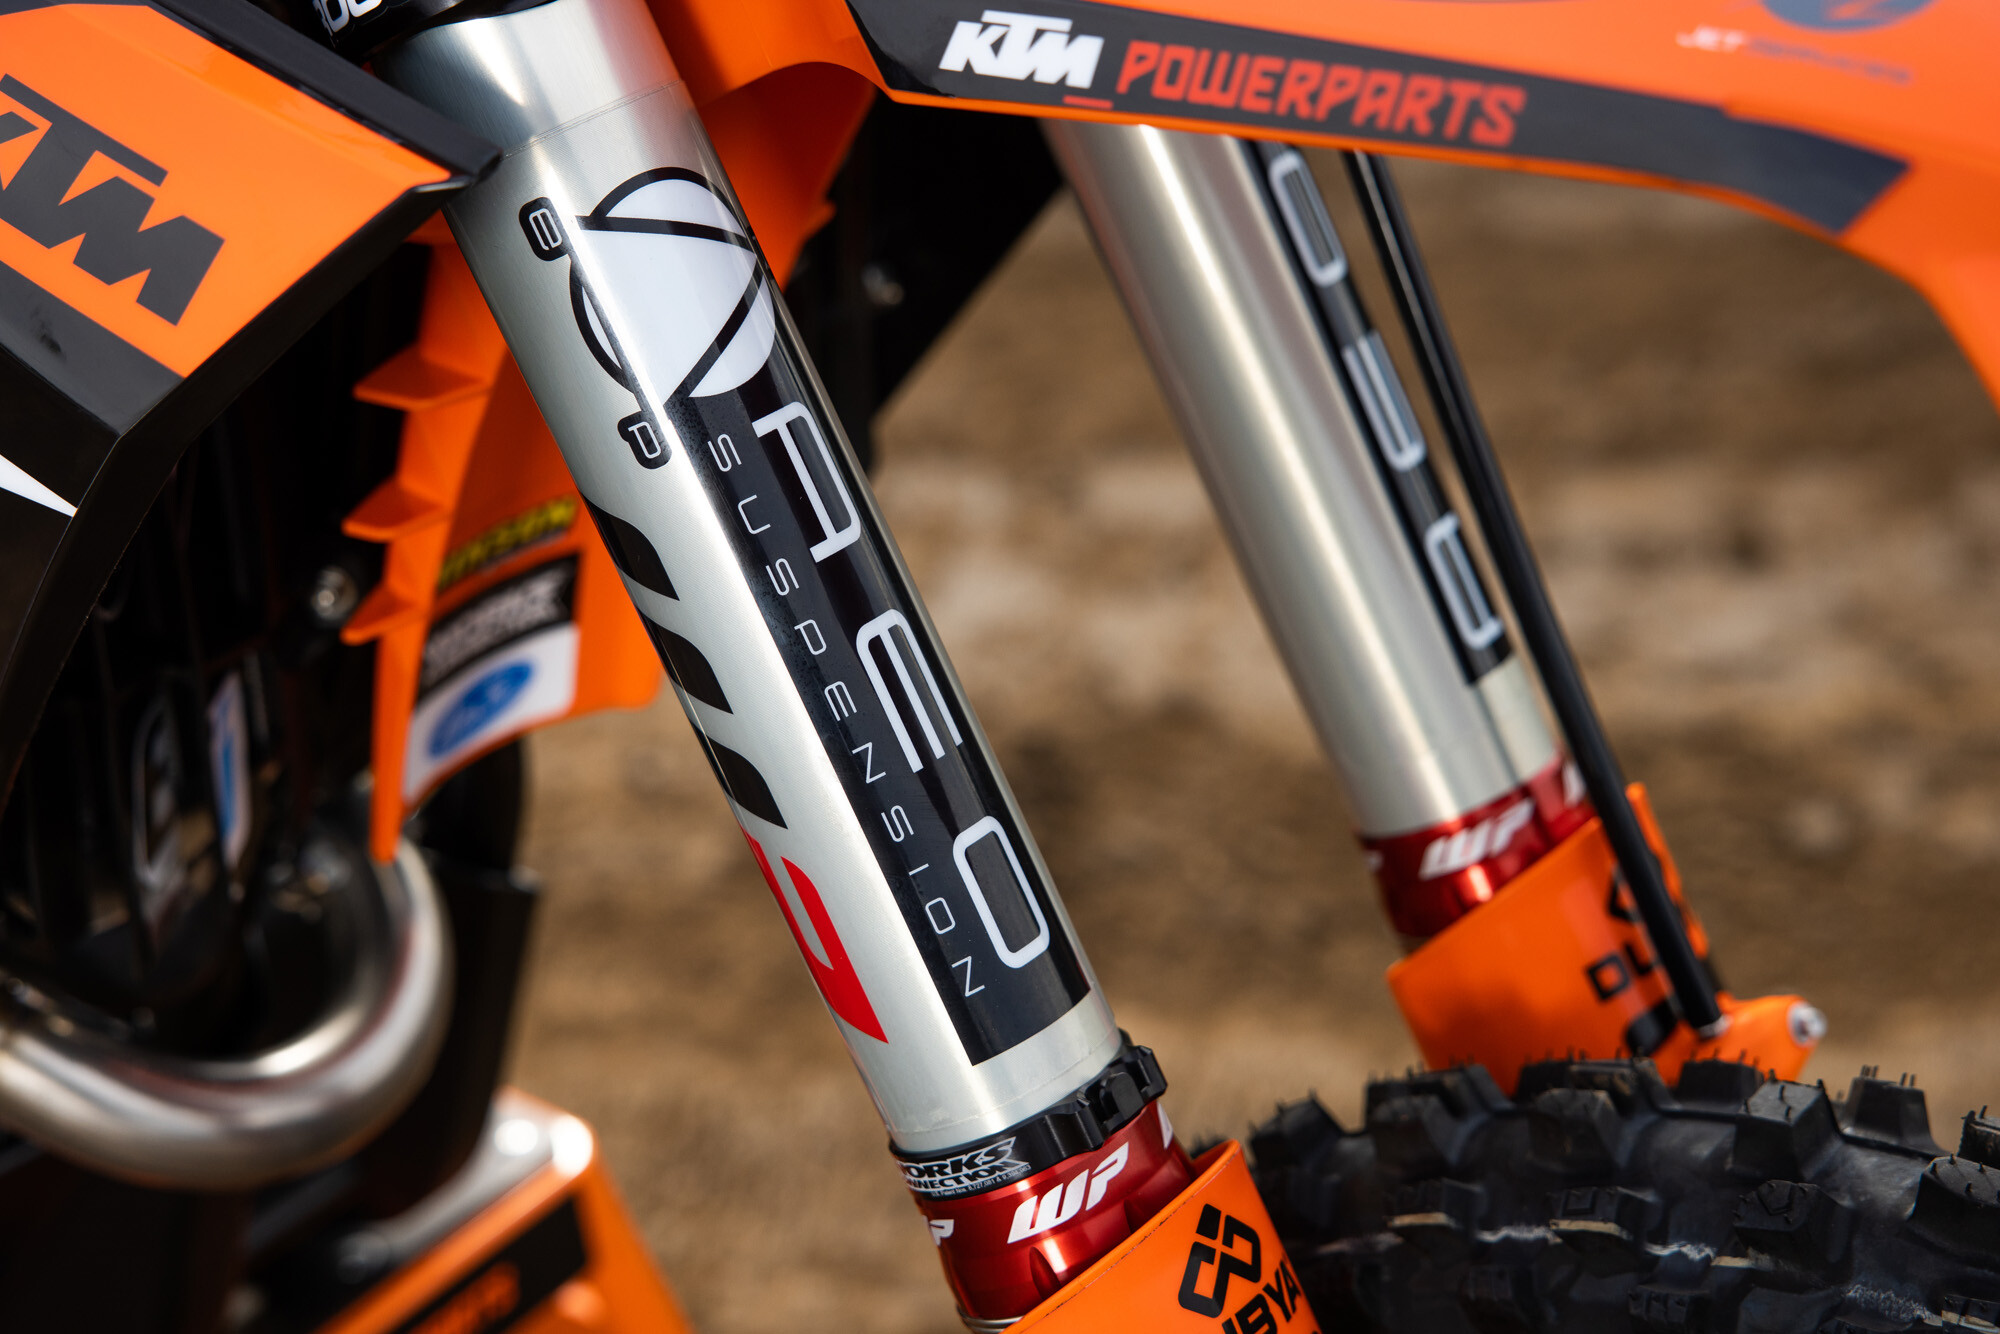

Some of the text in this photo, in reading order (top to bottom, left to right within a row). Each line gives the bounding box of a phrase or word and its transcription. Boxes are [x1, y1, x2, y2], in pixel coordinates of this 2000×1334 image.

[938, 9, 1527, 147] KTM POWERPARTS
[708, 433, 985, 997] SUSPENSION
[752, 401, 1050, 969] AEO
[898, 1136, 1017, 1179] ORKS
[1007, 1141, 1129, 1244] WP
